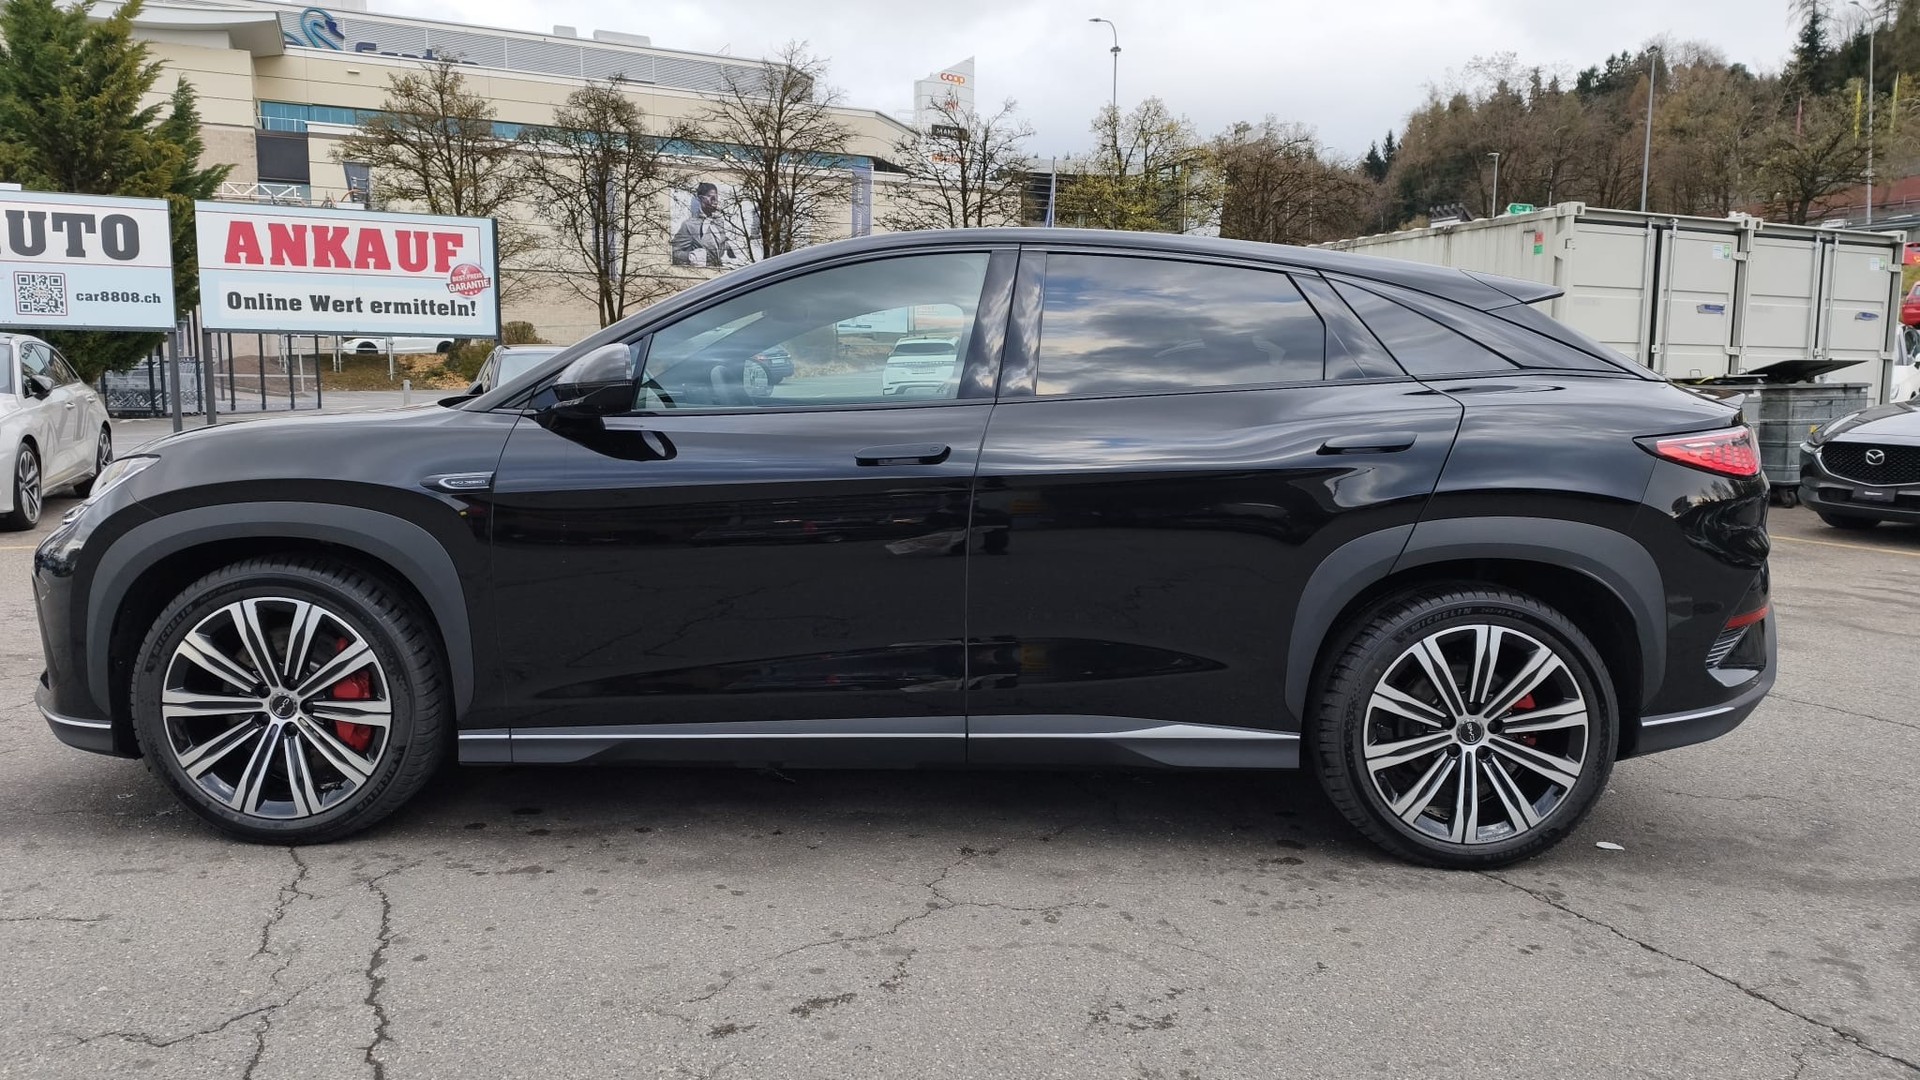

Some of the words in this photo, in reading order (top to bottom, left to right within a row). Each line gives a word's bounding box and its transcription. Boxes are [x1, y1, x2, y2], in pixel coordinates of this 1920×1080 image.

[940, 72, 966, 85] coop
[936, 127, 961, 137] MANO
[0, 209, 140, 261] UTO
[224, 220, 464, 273] ANKAUF
[448, 279, 490, 292] GARANTIE
[76, 291, 161, 304] car8808.ch
[227, 291, 302, 312] Online
[309, 294, 363, 314] Wert
[370, 297, 476, 317] ermitteln!
[1411, 607, 1473, 632] MICHELIN
